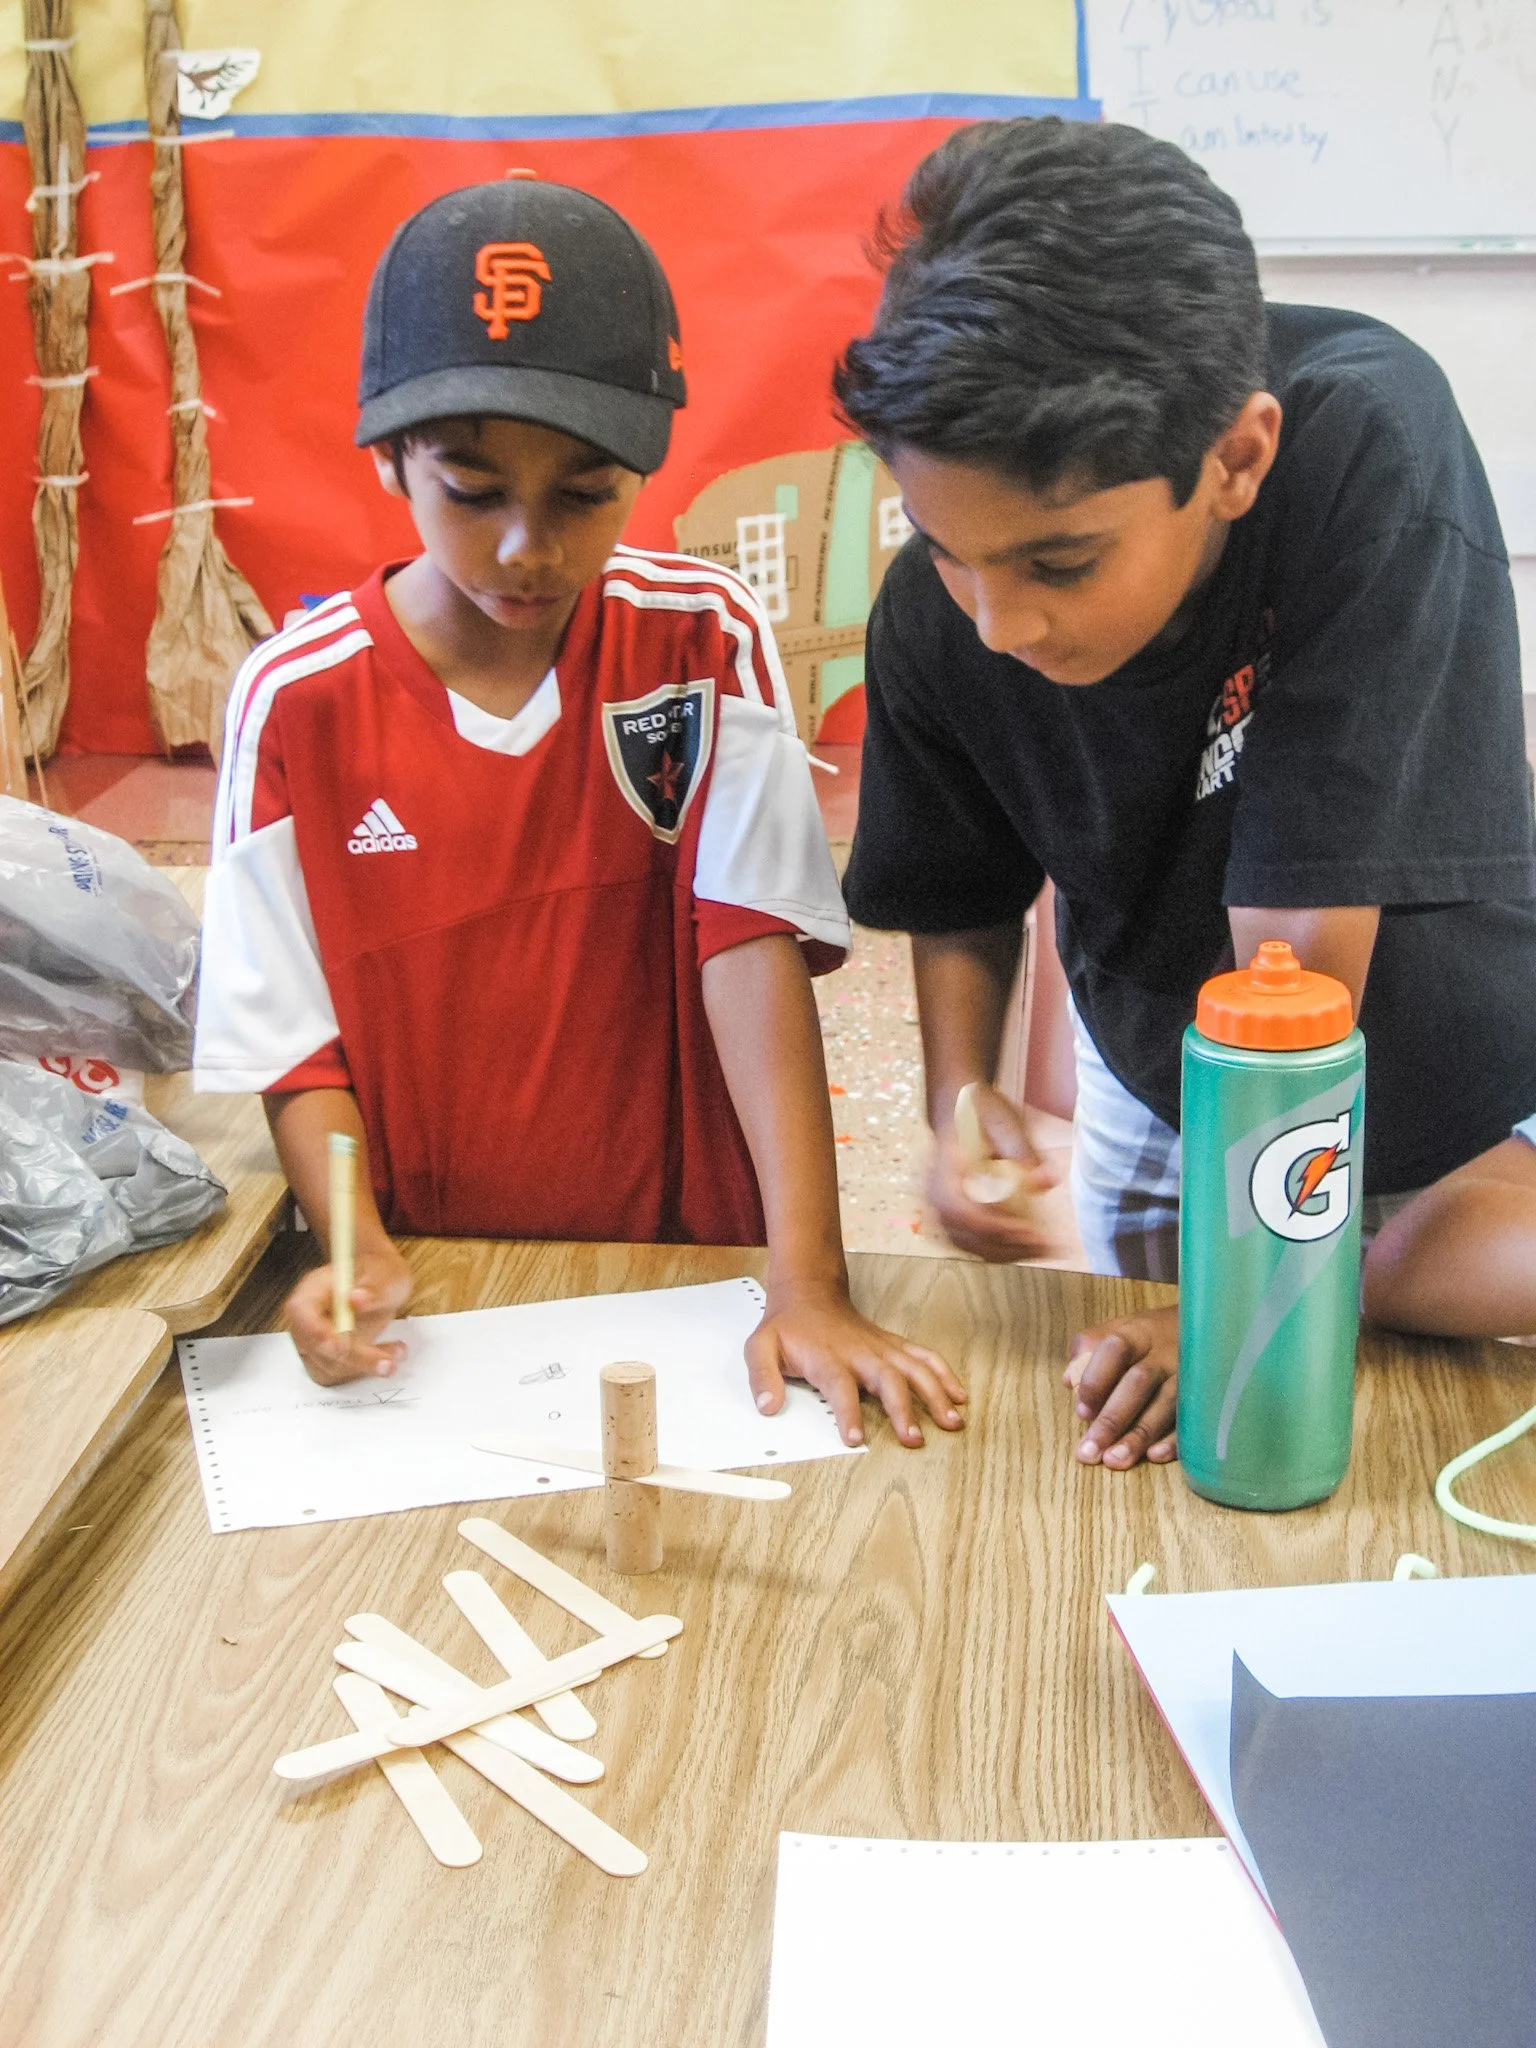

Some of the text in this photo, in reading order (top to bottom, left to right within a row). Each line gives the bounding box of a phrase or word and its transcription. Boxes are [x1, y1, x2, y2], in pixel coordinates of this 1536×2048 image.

[1175, 68, 1240, 98] can
[622, 713, 667, 736] RED
[347, 833, 418, 855] adidas
[1248, 1108, 1352, 1243] G
